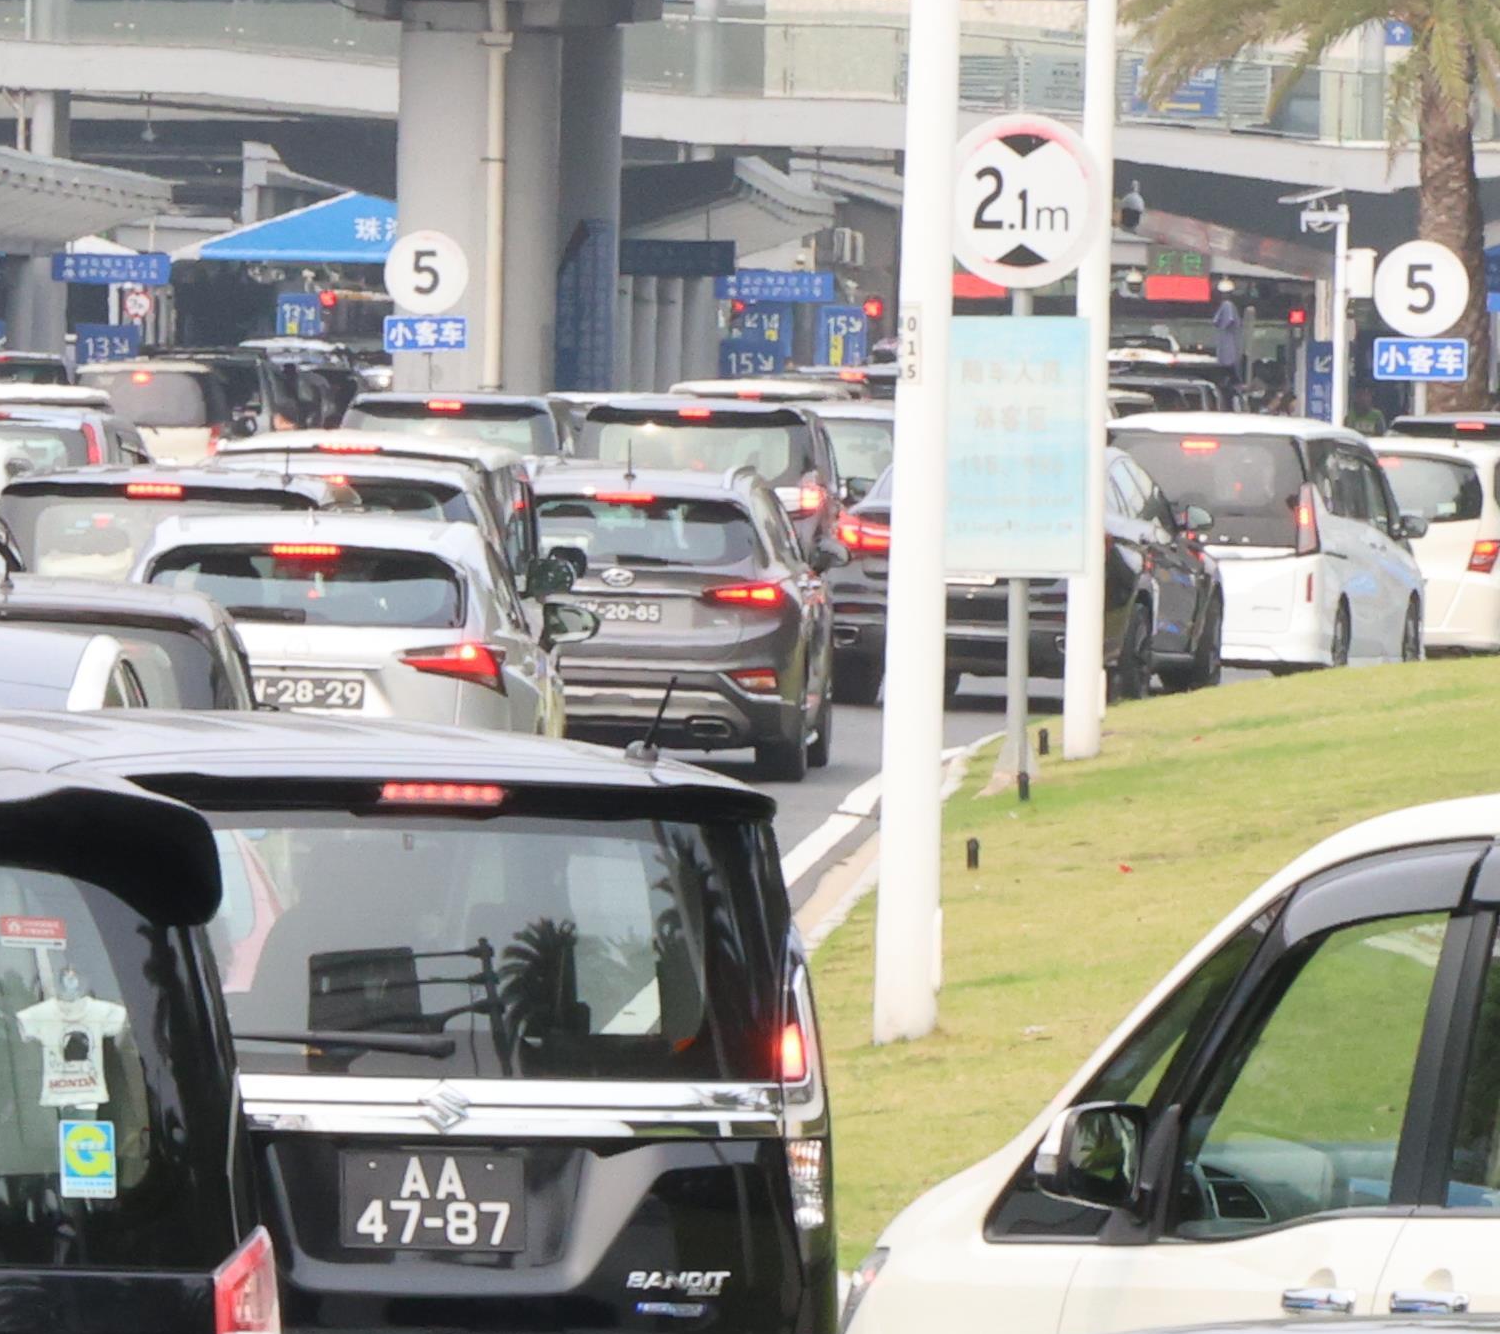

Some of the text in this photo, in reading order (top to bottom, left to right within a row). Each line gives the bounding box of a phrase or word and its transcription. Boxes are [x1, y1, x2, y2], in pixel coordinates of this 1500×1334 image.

[972, 165, 1070, 233] 2.1m
[413, 250, 438, 295] 5
[1406, 264, 1436, 314] 5
[85, 336, 111, 358] 13
[388, 321, 466, 347] 小客车
[1379, 347, 1464, 375] 小客车
[577, 602, 660, 621] -20-65
[49, 1076, 98, 1090] HONDA
[400, 1155, 467, 1200] AA
[356, 1199, 511, 1246] 47-87
[626, 1270, 731, 1289] BANDIT
